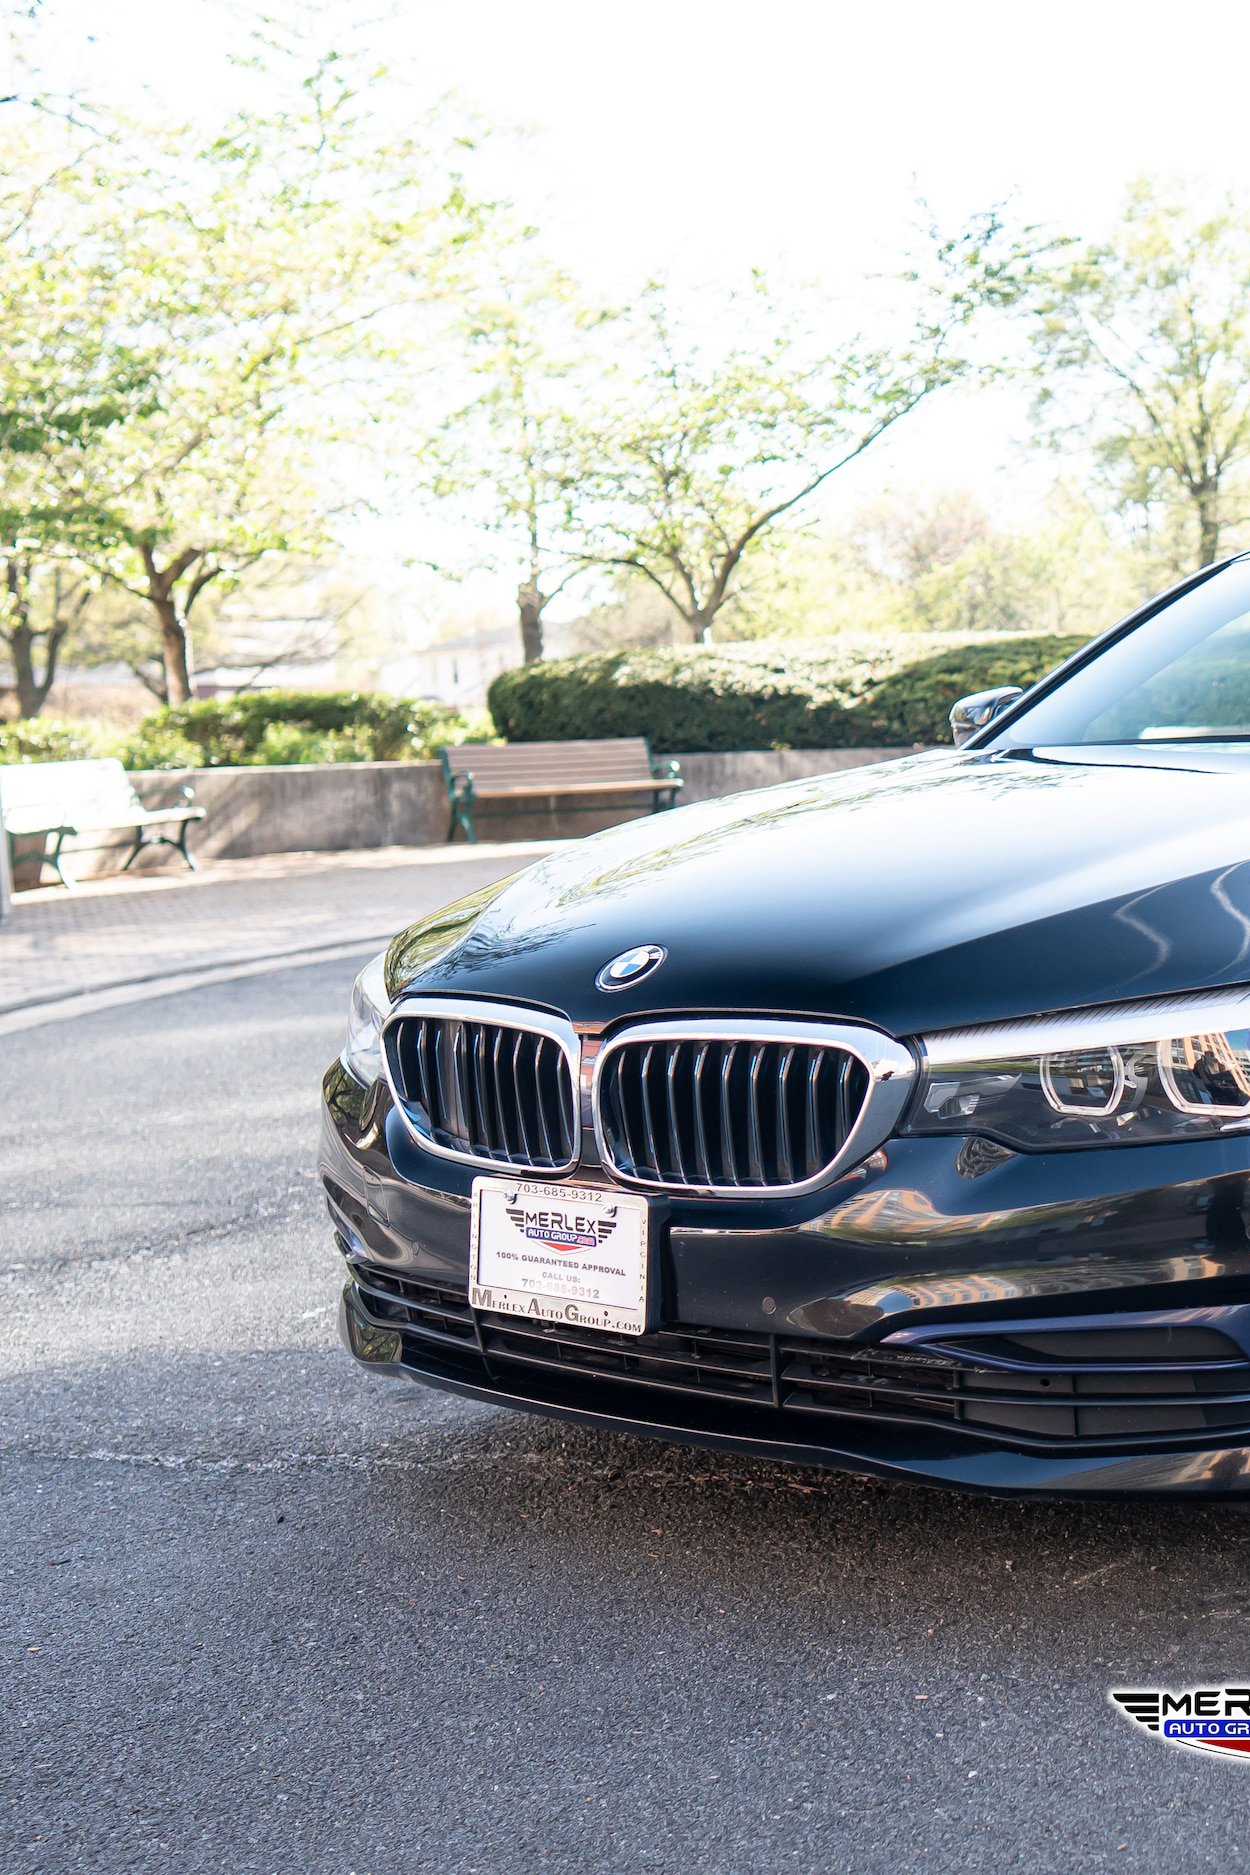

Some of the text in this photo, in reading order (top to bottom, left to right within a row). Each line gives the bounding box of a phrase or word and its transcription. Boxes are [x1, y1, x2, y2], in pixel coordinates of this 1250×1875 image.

[516, 1183, 602, 1202] 703-685-9312
[525, 1211, 596, 1234] MERLEX
[527, 1228, 550, 1239] AUTO
[496, 1251, 626, 1276] 100% GUARANTEED APPROVAL
[638, 1219, 647, 1302] VIRGINIA
[542, 1271, 581, 1284] CALL US:
